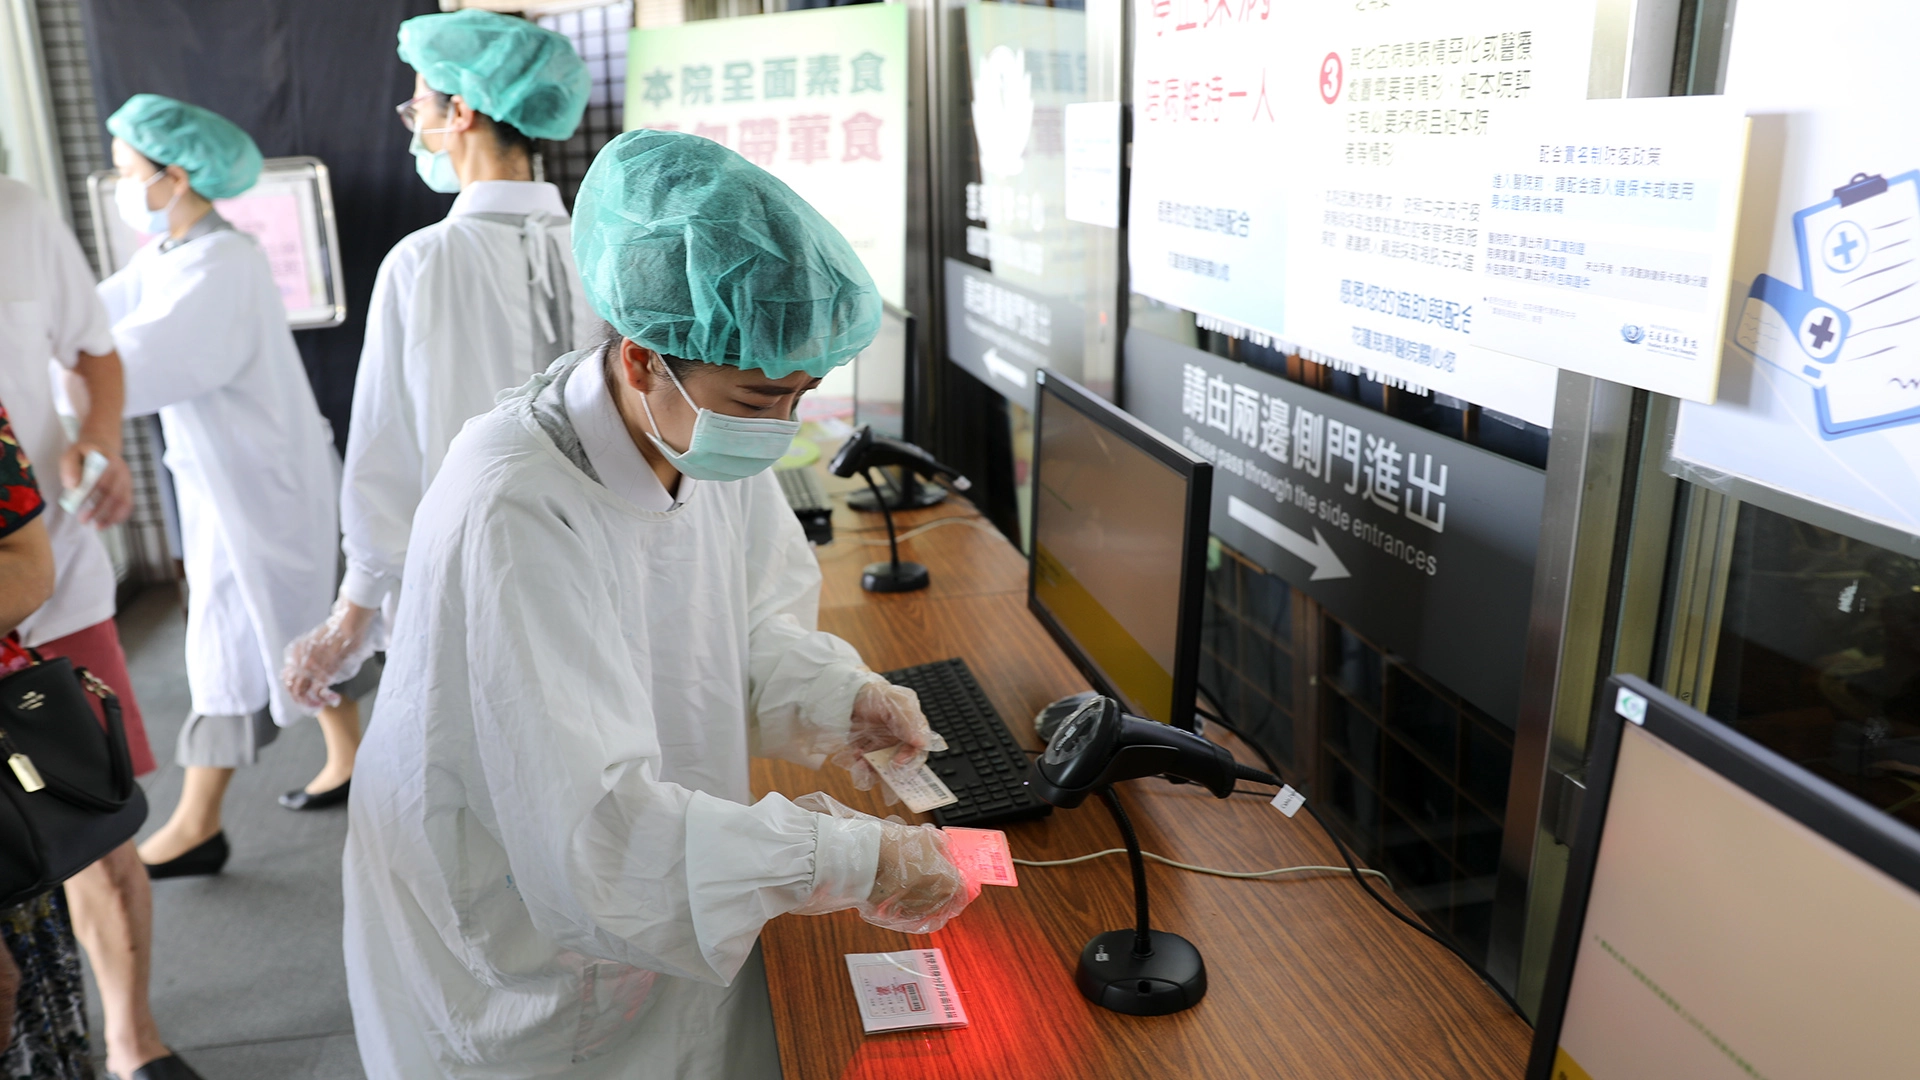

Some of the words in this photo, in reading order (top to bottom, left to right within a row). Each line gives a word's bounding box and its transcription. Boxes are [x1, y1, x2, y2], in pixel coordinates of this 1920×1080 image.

[641, 51, 885, 110] 本院全面素食
[641, 111, 884, 166] 勿帶葷食
[1539, 144, 1662, 166] 配合實名制防疫政策
[1182, 363, 1449, 533] 請由兩邊側門進出
[1182, 426, 1216, 465] Please
[1216, 443, 1244, 478] pass
[1245, 457, 1293, 503] through
[1294, 484, 1317, 515] the
[1318, 500, 1350, 532] side
[1353, 517, 1438, 576] entrances
